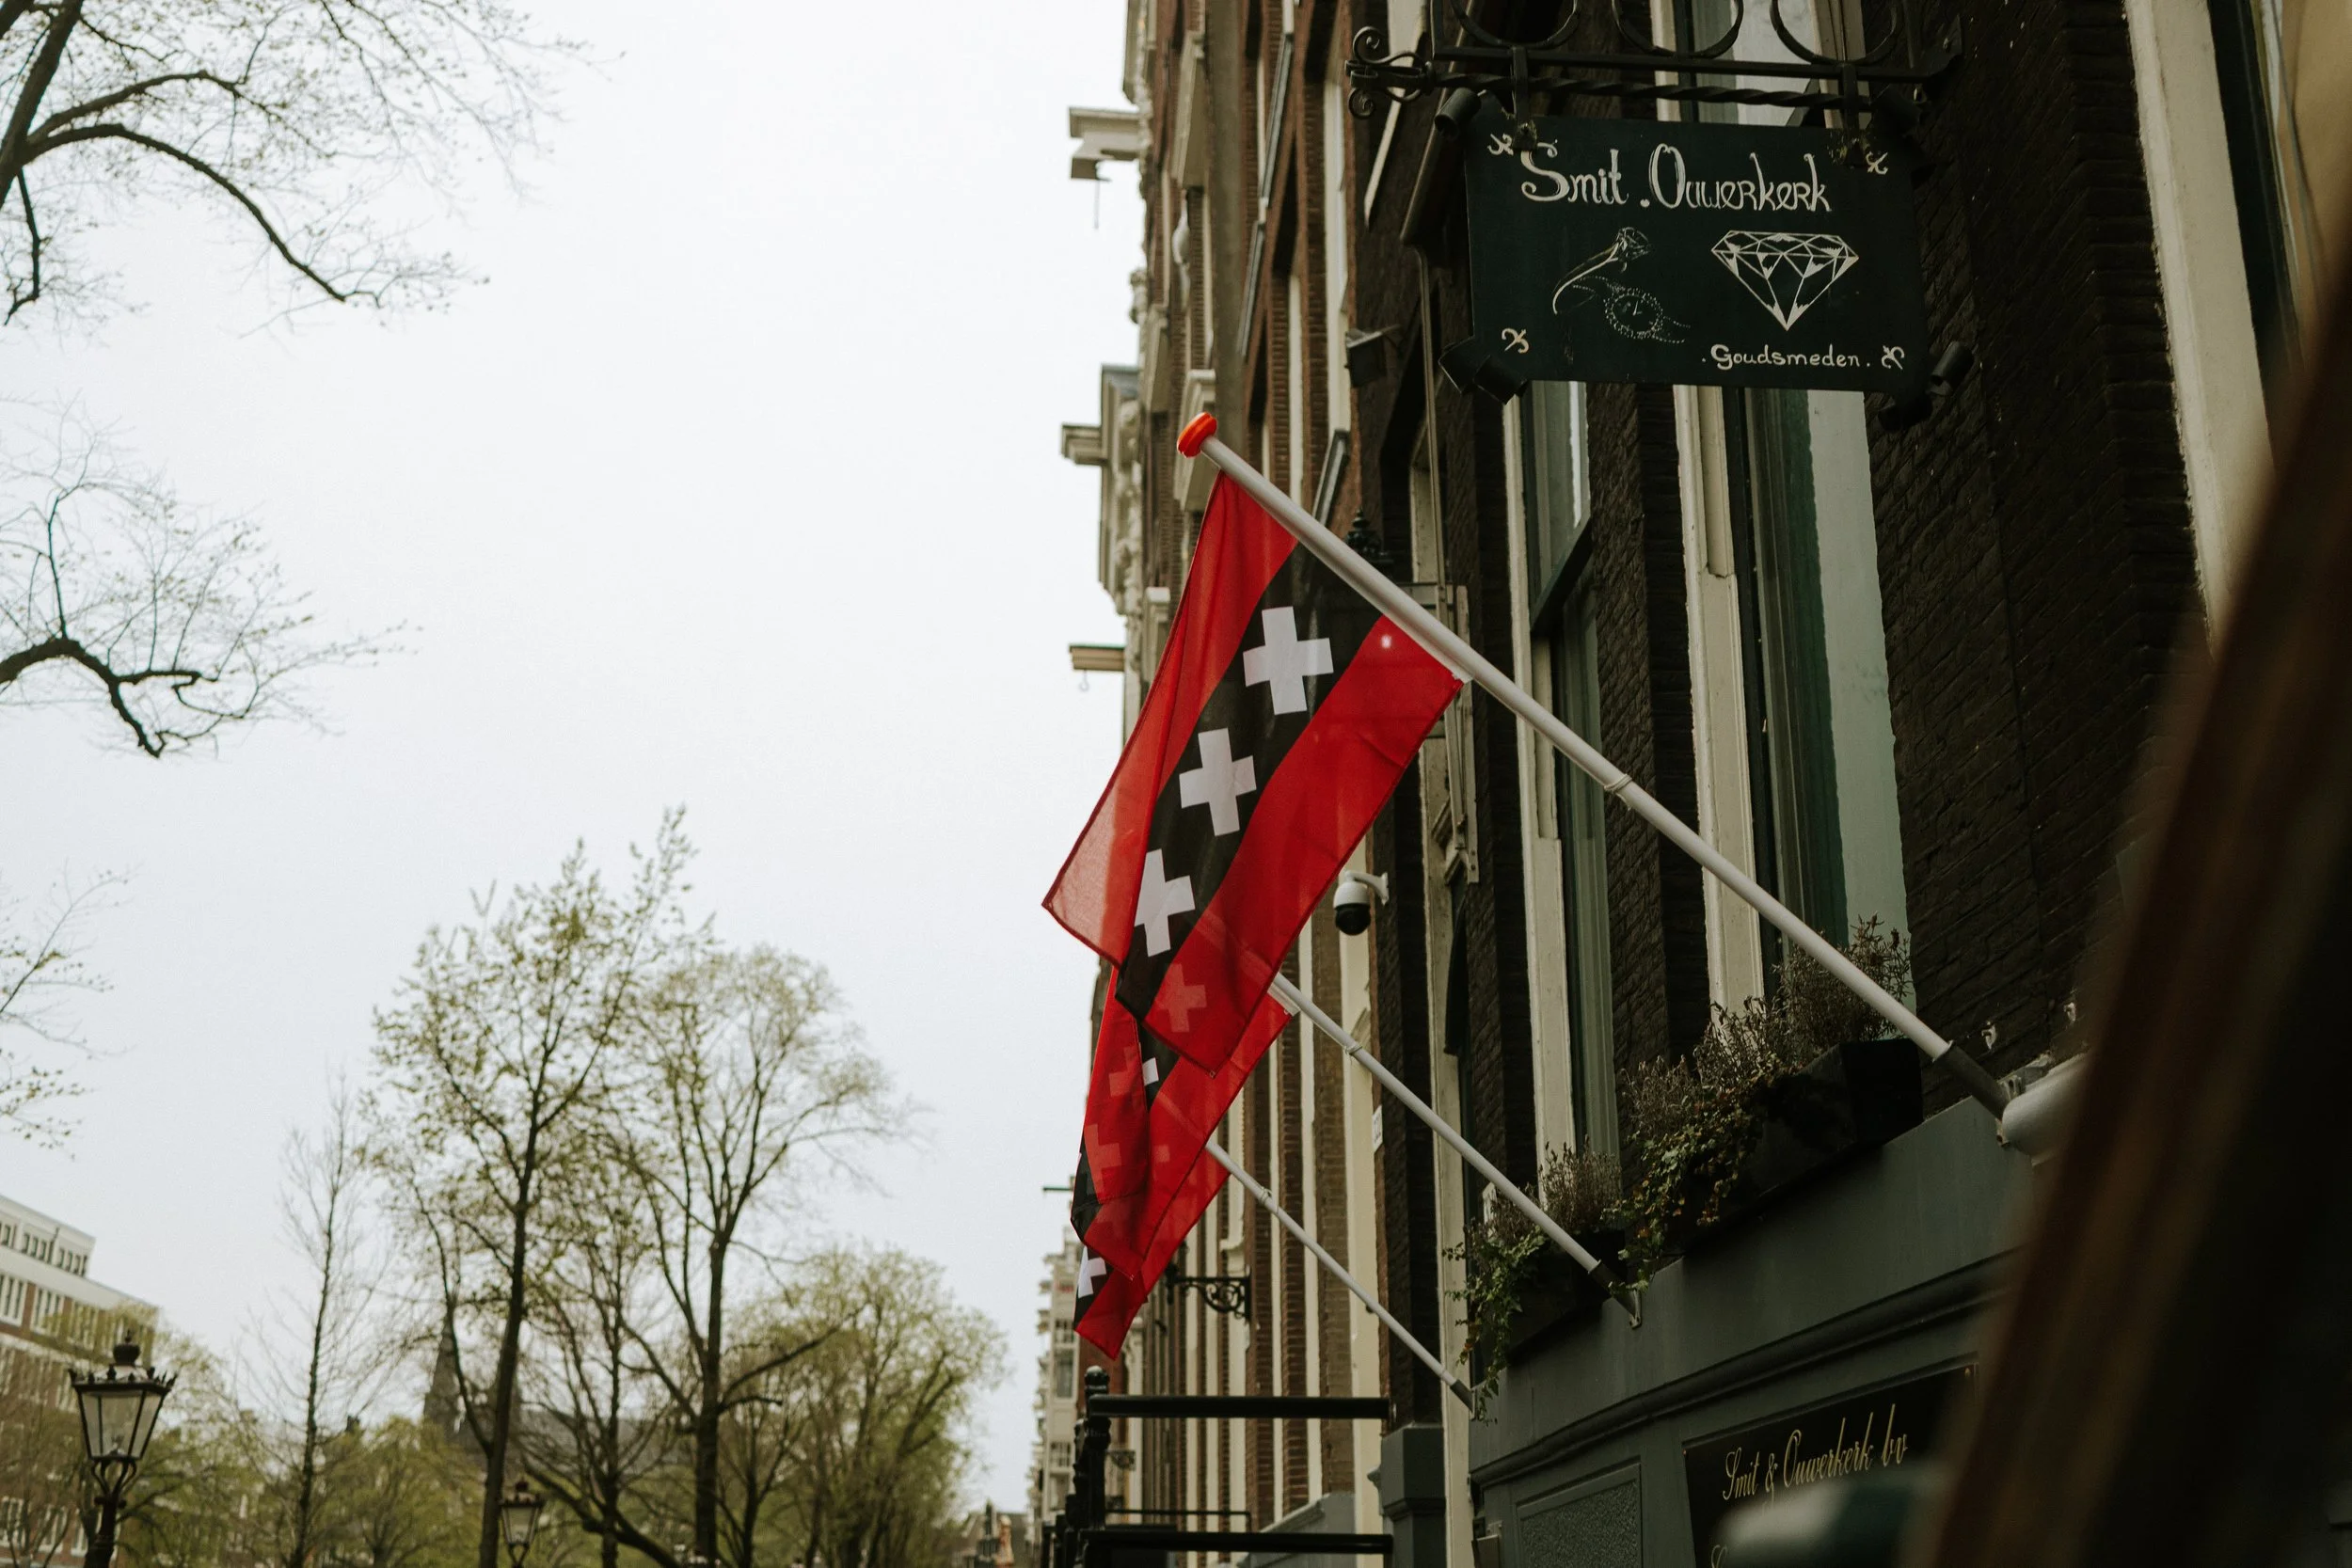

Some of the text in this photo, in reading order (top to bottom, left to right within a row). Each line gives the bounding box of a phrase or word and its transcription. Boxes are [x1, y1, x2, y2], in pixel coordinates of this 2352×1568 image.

[1521, 141, 1629, 203] Smit
[1722, 1447, 1761, 1500] Smit
[1764, 1452, 1779, 1493] &
[1783, 1411, 1875, 1488] Ouwerkerk
[1881, 1402, 1909, 1467] bv
